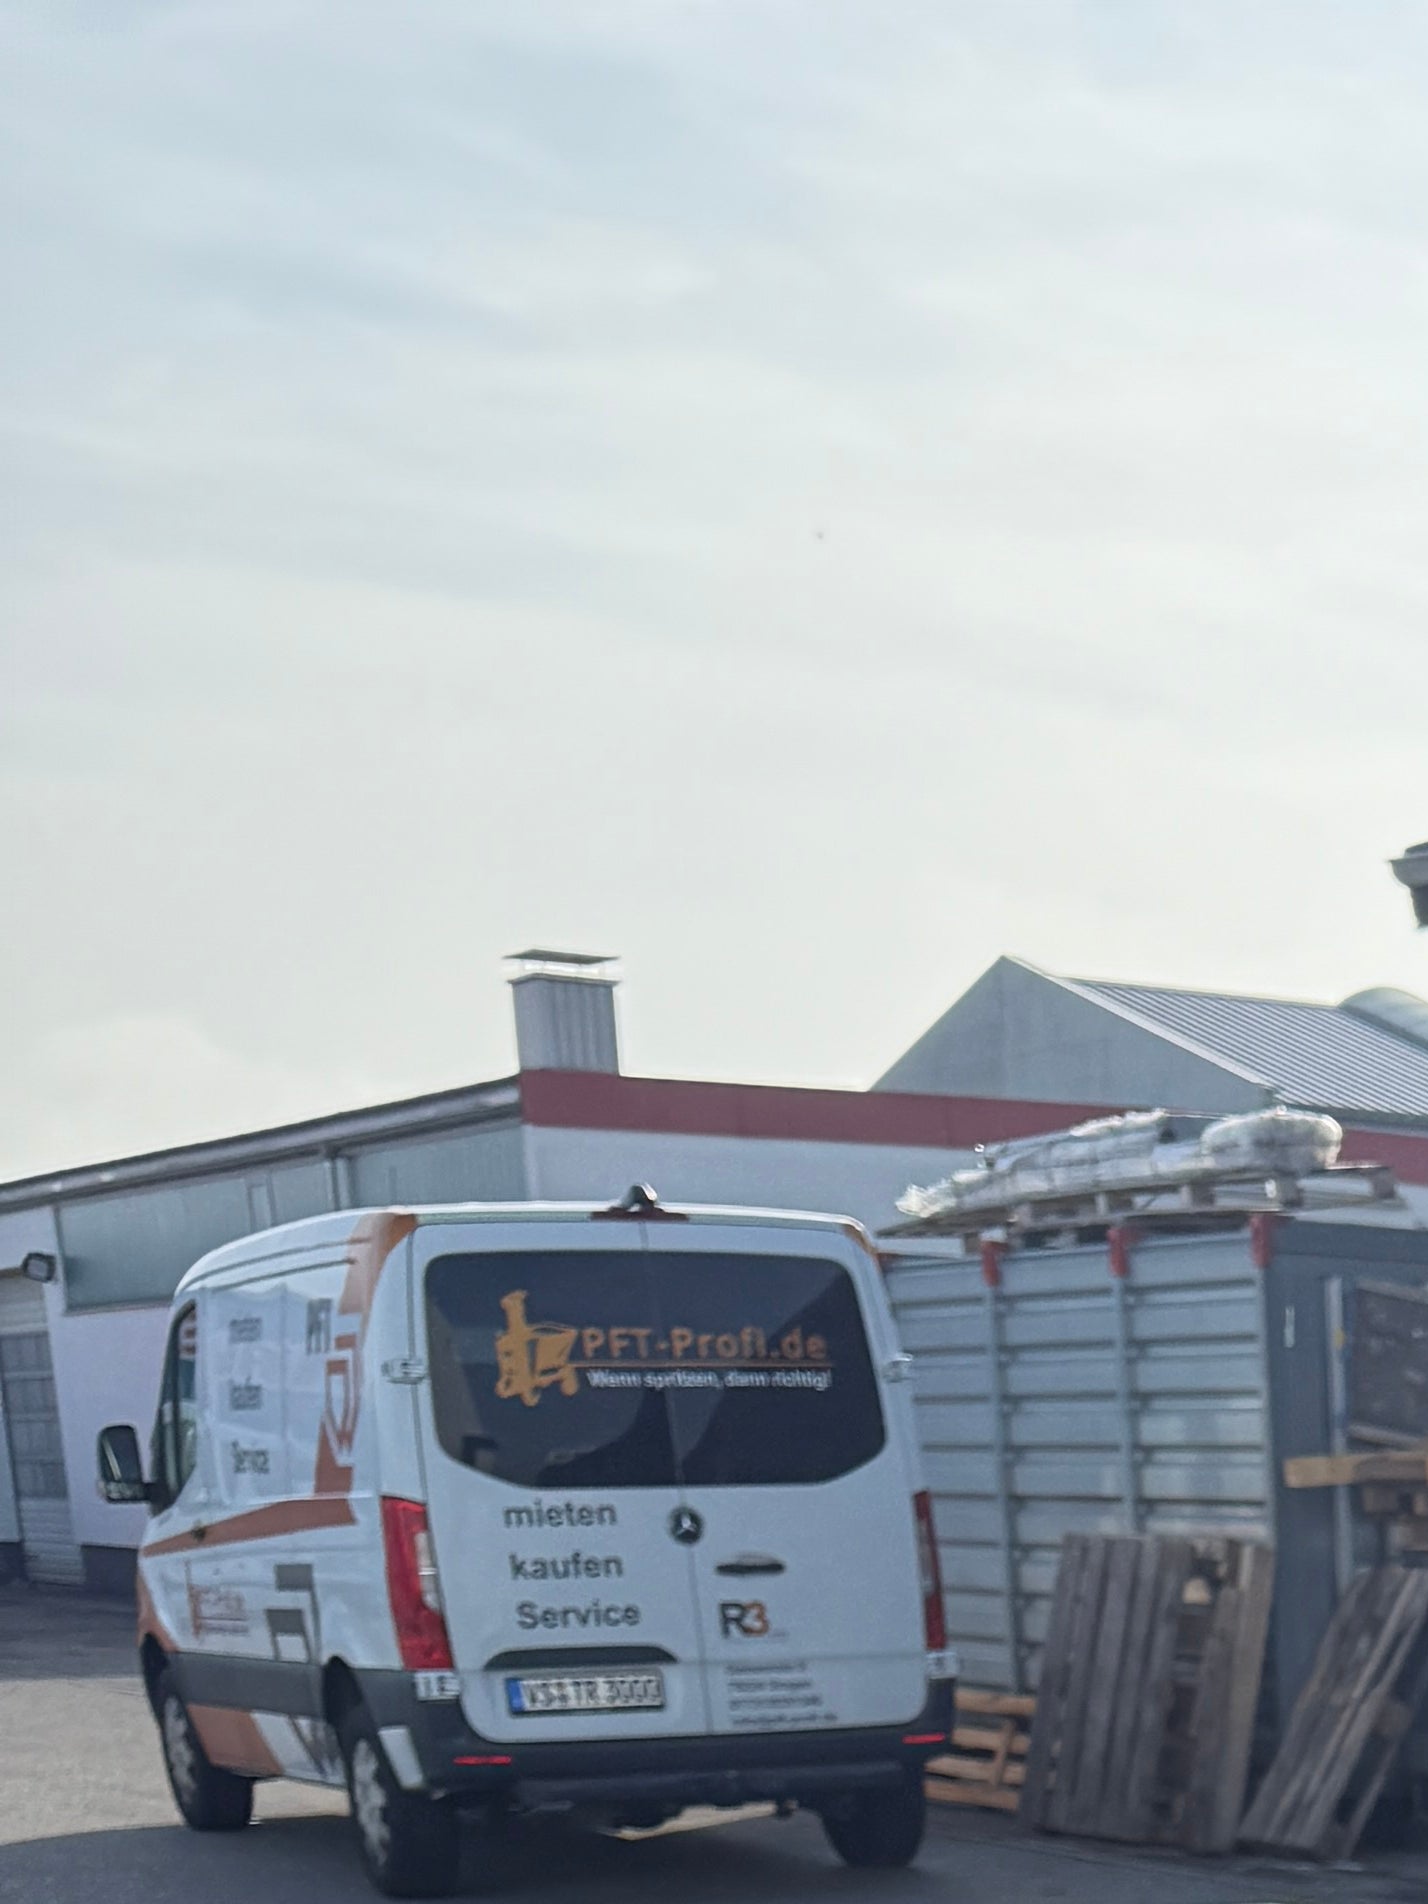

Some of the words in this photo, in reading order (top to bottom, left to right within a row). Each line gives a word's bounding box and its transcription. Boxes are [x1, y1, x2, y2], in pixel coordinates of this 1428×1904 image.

[581, 1325, 829, 1360] PFT-Profi.de
[503, 1500, 617, 1529] mieten
[509, 1552, 624, 1581] kaufen
[515, 1598, 641, 1630] Service
[718, 1601, 769, 1639] R3
